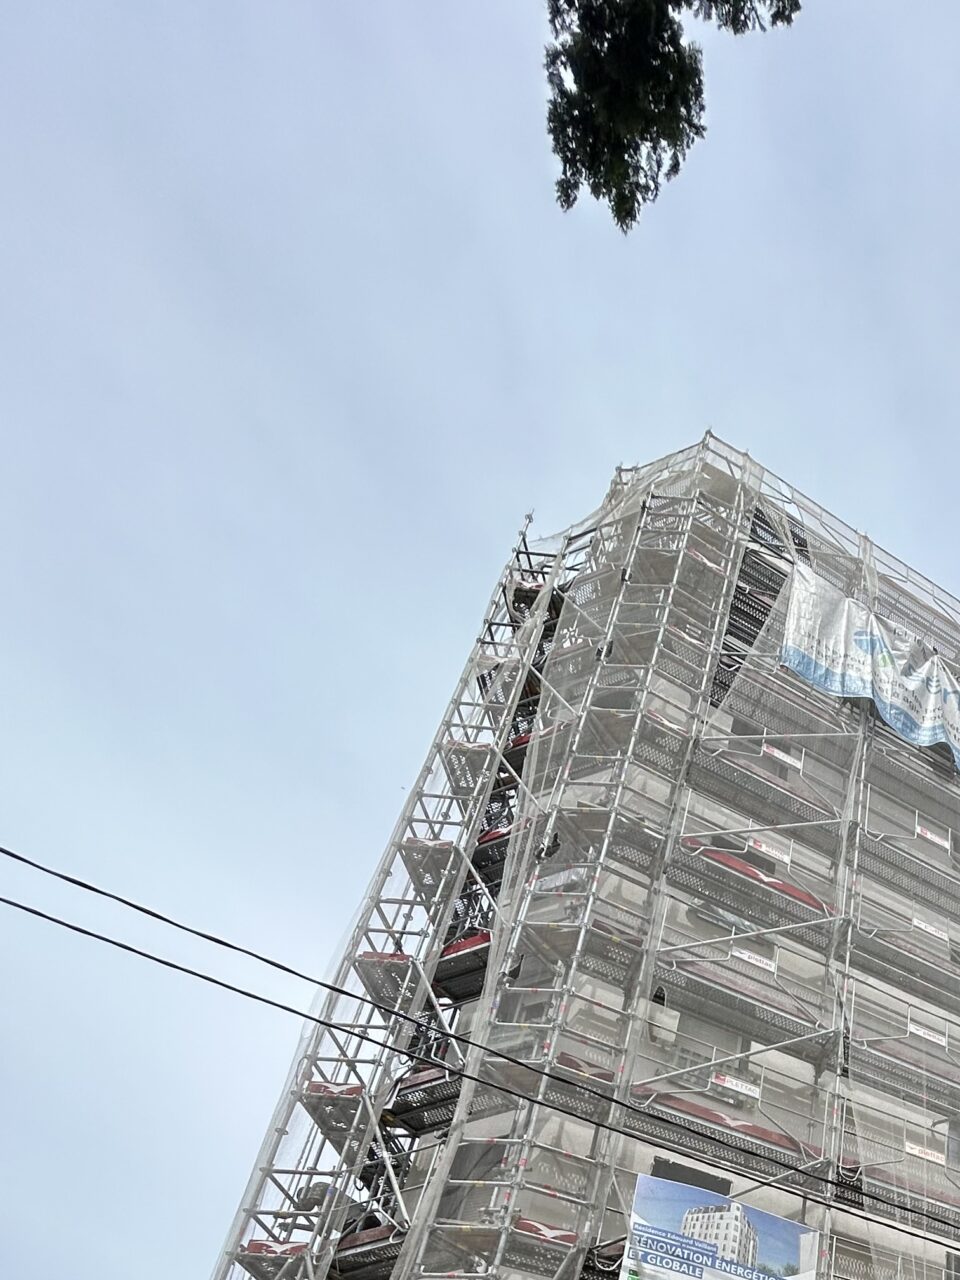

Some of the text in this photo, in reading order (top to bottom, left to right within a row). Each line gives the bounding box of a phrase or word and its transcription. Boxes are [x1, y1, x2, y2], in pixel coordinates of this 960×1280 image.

[629, 1248, 702, 1278] ET GLOBALE
[632, 1234, 712, 1266] RÉNOVATION
